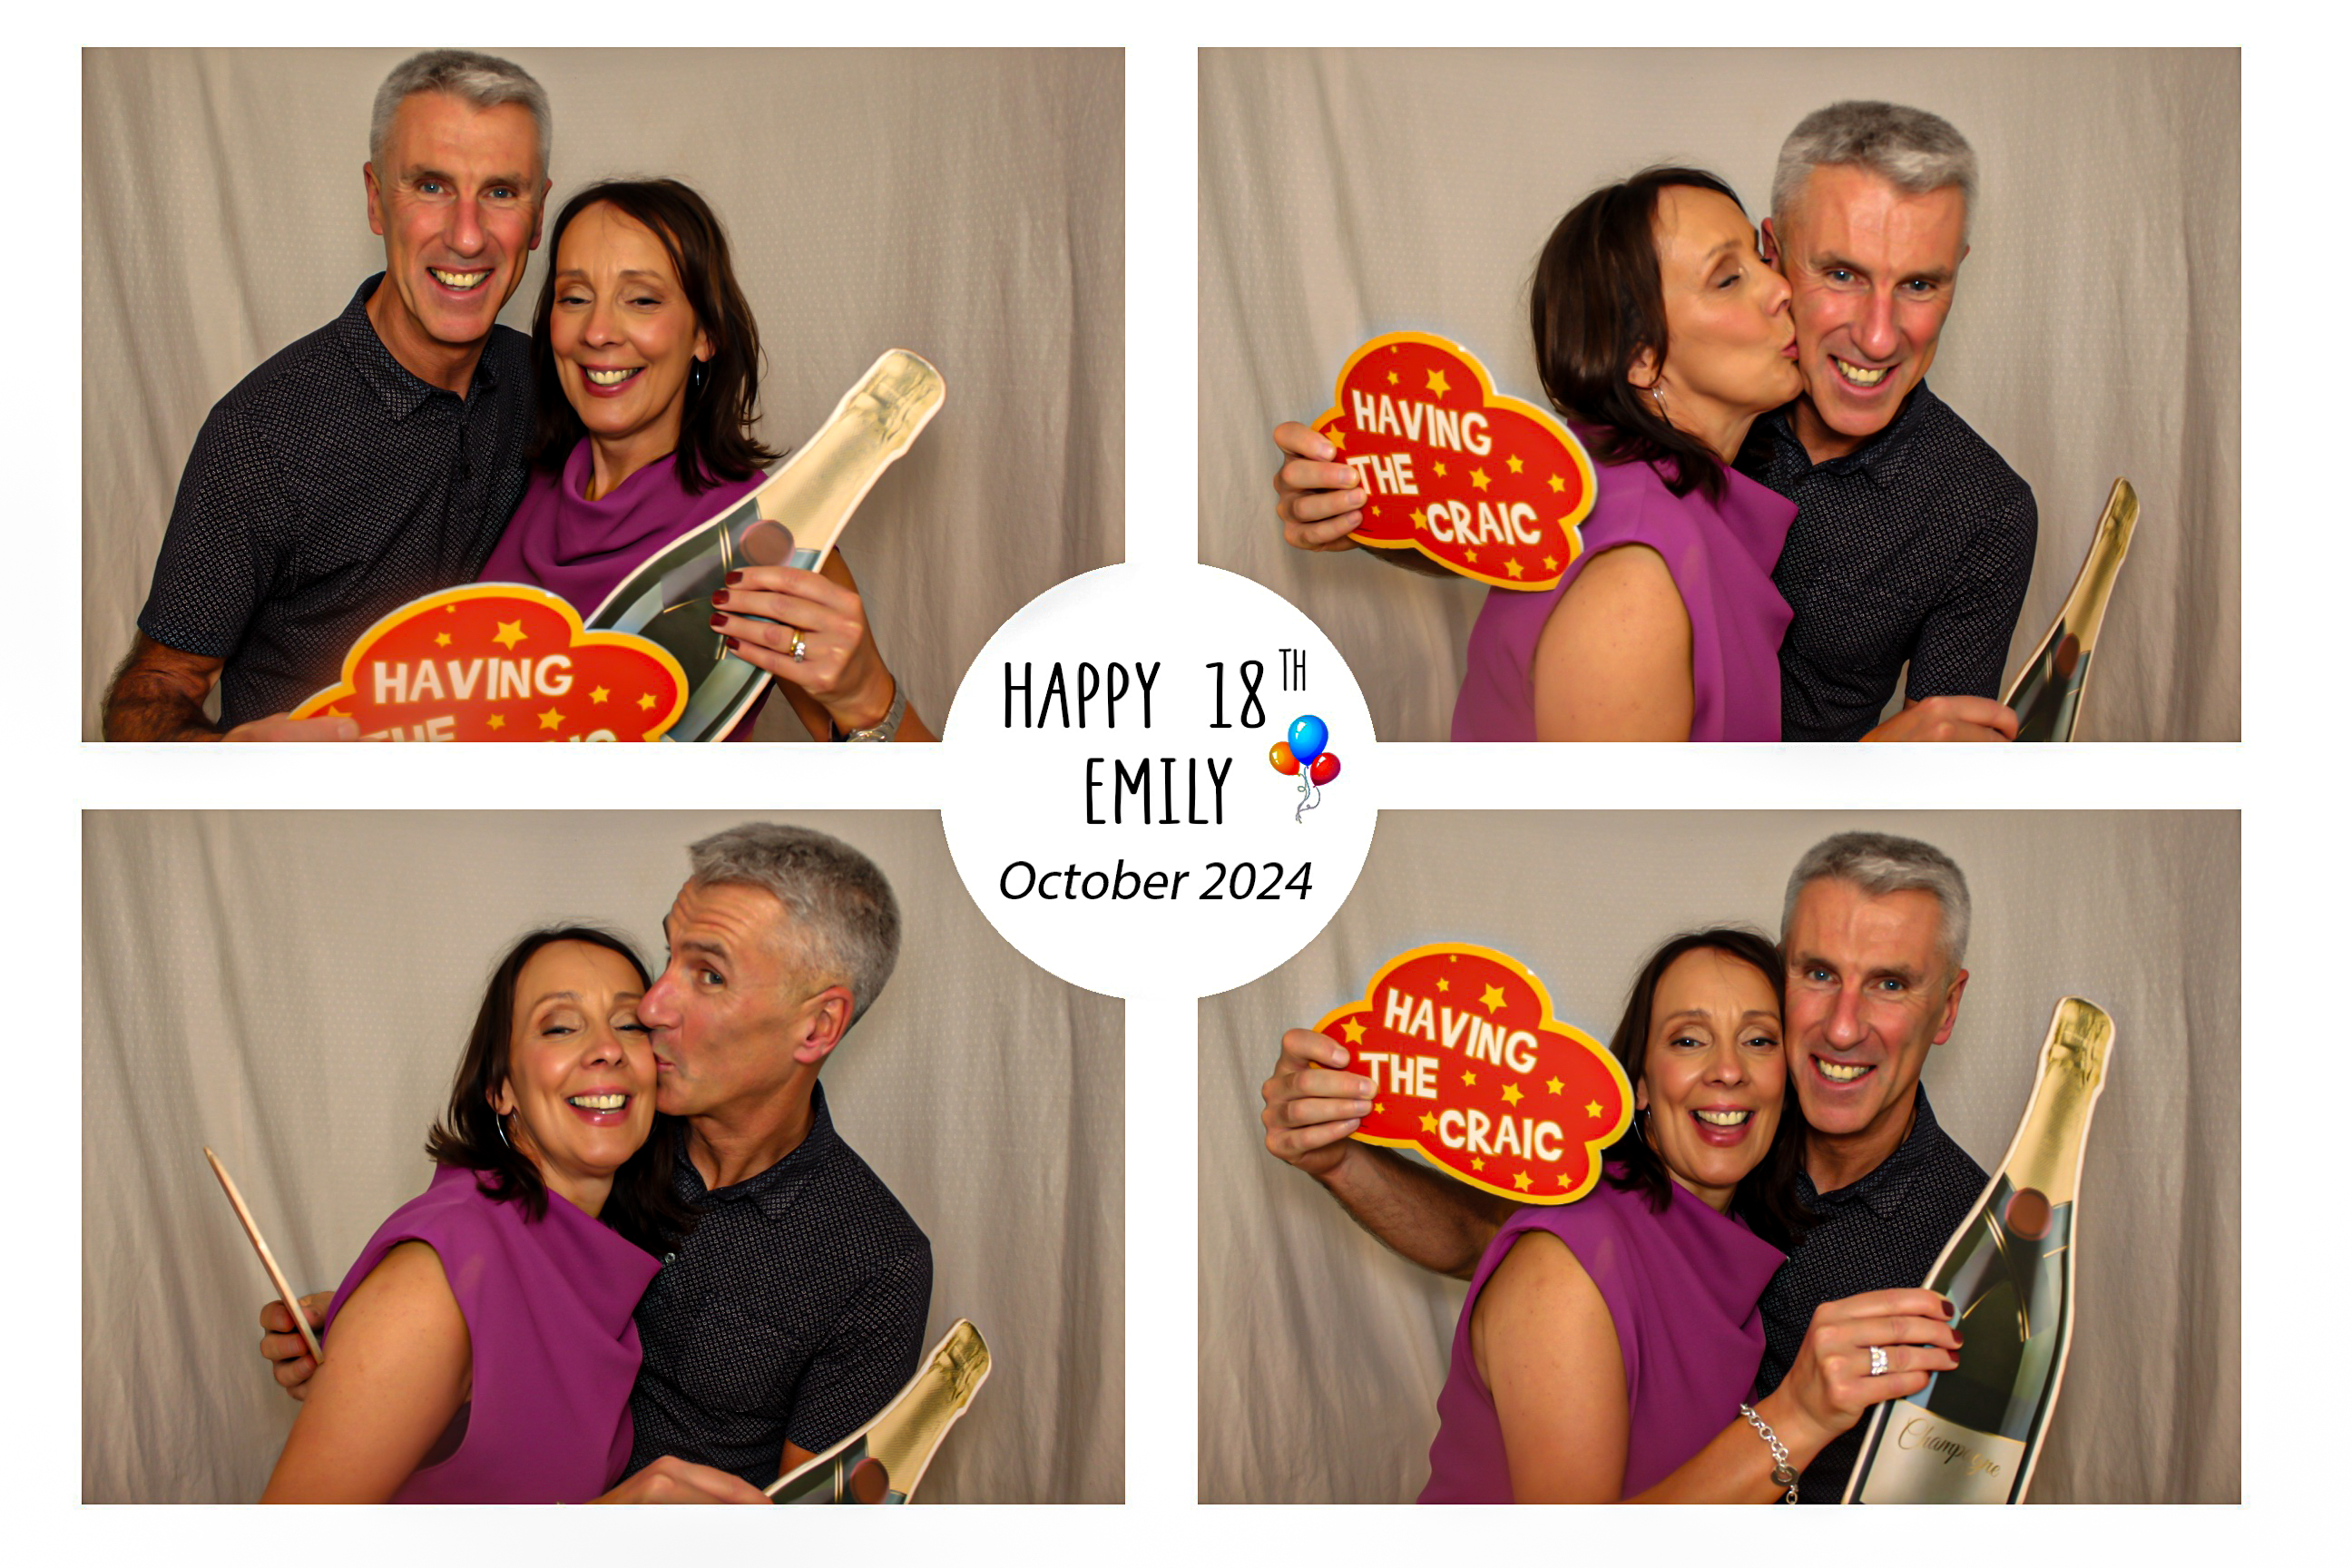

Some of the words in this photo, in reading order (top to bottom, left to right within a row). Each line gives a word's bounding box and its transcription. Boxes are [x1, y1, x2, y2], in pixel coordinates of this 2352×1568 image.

[1352, 388, 1492, 456] HAVING
[1346, 453, 1419, 495] THE
[1426, 500, 1542, 545] CRAIC
[373, 654, 573, 704] HAVING
[1384, 987, 1539, 1074] HAVING
[1358, 1052, 1438, 1099] THE
[1438, 1109, 1563, 1161] CRAIC
